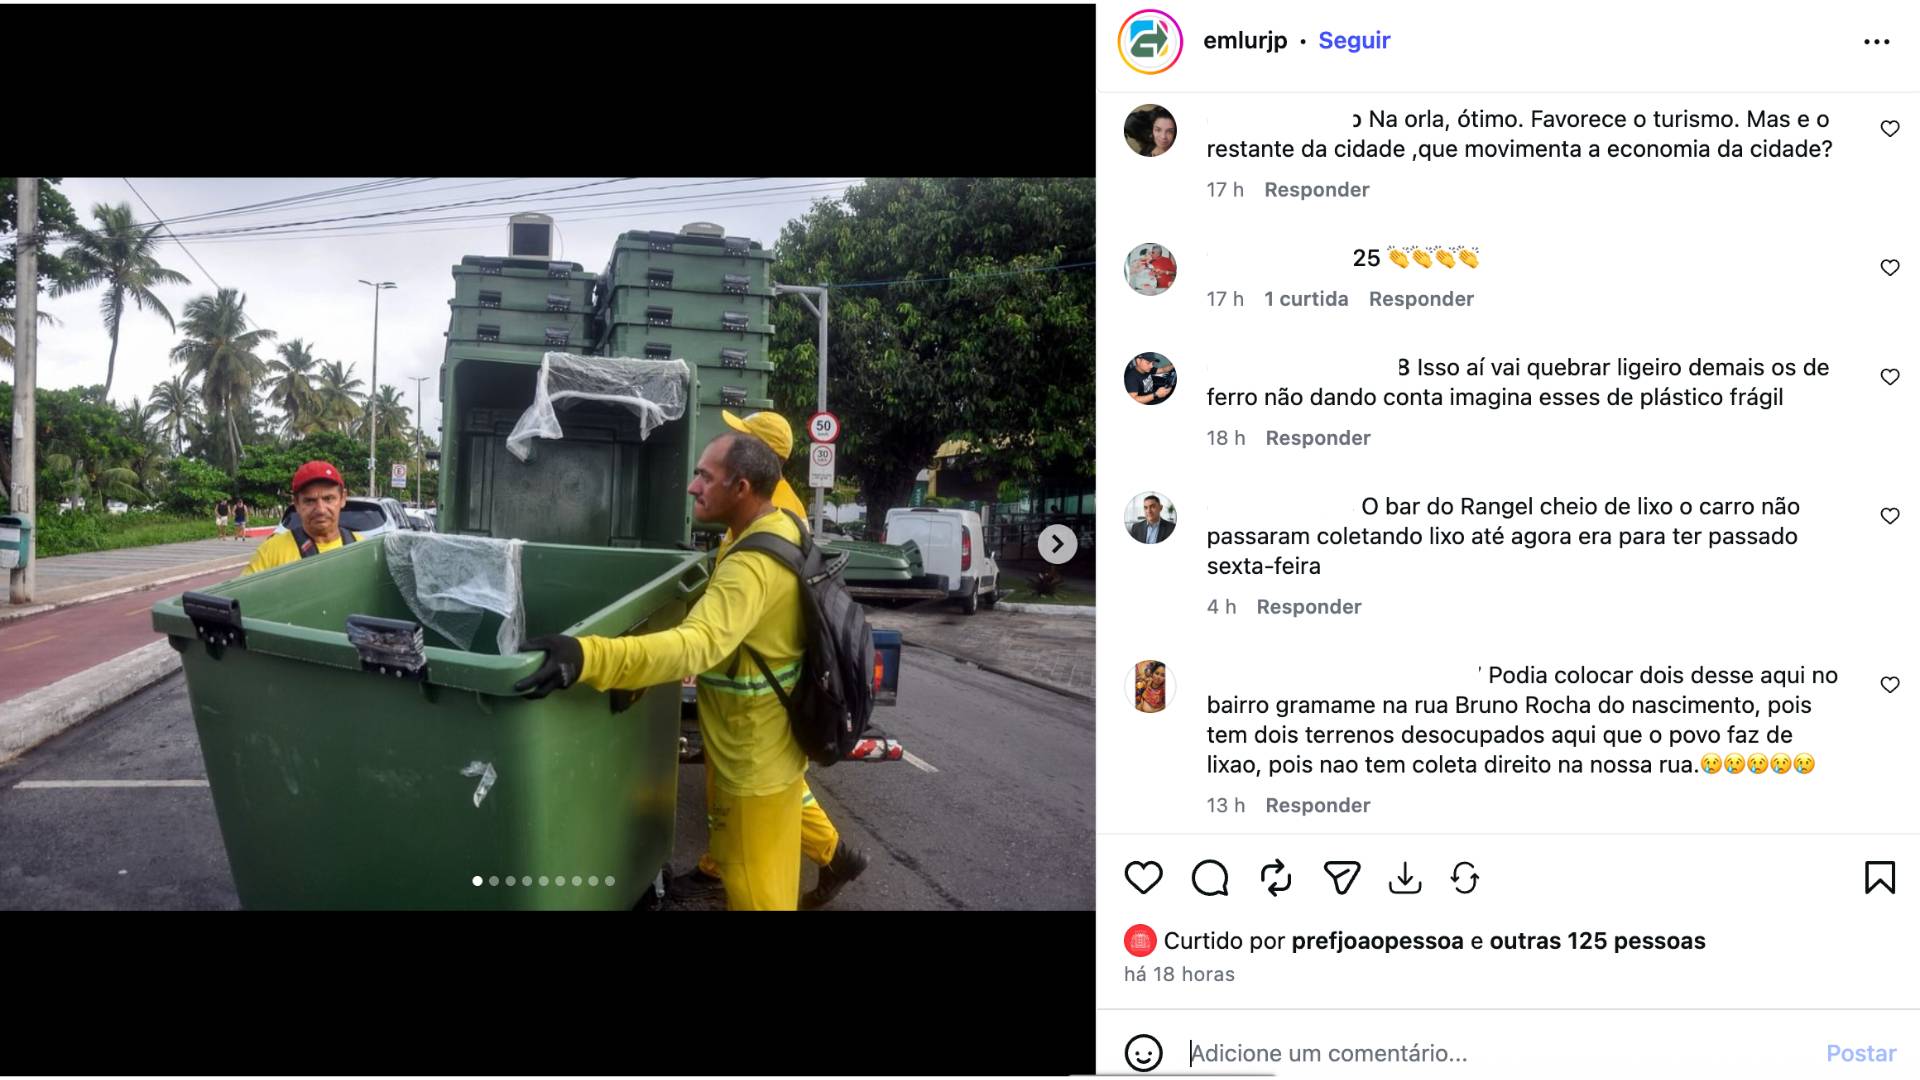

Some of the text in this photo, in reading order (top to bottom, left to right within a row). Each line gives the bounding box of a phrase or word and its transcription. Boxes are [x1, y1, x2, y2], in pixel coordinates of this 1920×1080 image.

[1203, 29, 1288, 54] emlurjp
[1318, 29, 1392, 54] Seguir
[1369, 109, 1398, 128] Na
[1404, 108, 1450, 132] orla,
[1457, 108, 1524, 128] ótimo.
[1531, 109, 1627, 129] Favorece
[1633, 113, 1647, 128] o
[1652, 108, 1740, 128] turismo.
[1747, 109, 1791, 128] Mas
[1797, 113, 1810, 128] e
[1816, 113, 1830, 128] o
[1207, 138, 1833, 162] restante da cidade ,que movimenta a economia da cidade?
[1207, 180, 1244, 198] 17 h
[1264, 180, 1371, 201] Responder
[1353, 248, 1381, 268] 25
[1206, 290, 1244, 307] 17 h
[1264, 289, 1349, 307] 1 curtida
[1369, 290, 1475, 310] Responder
[1417, 357, 1460, 377] Isso
[1466, 356, 1486, 377] aí
[1490, 357, 1521, 377] vai
[1526, 357, 1612, 381] quebrar
[1617, 357, 1682, 381] ligeiro
[1688, 357, 1765, 377] demais
[1771, 361, 1797, 377] os
[1802, 357, 1830, 377] de
[1205, 386, 1784, 411] ferro não dando conta imagina esses de plástico frágil
[816, 420, 831, 431] 50
[1207, 429, 1246, 446] 18 h
[1266, 429, 1372, 449] Responder
[817, 450, 829, 458] 30
[1361, 496, 1801, 520] O bar do Rangel cheio de lixo o carro não
[1207, 525, 1799, 550] passaram coletando lixo até agora era para ter passado
[1207, 555, 1321, 575] sexta-feira
[1206, 597, 1237, 615] 4 h
[1257, 598, 1363, 619] Responder
[1489, 664, 1839, 689] Podia colocar dois desse aqui no
[1207, 694, 1812, 718] bairro gramame na rua Bruno Rocha do nascimento, pois
[1205, 724, 1793, 748] tem dois terrenos desocupados aqui que o povo faz de
[1207, 754, 1699, 778] lixao, pois nao tem coleta direito na nossa rua.
[1207, 796, 1246, 813] 13 h
[1266, 796, 1372, 817] Responder
[1163, 929, 1707, 954] Curtido por prefjoaopessoa e outras 125 pessoas
[1124, 964, 1235, 982] há 18 horas
[1191, 1042, 1468, 1063] Adicione um comentário...
[1827, 1044, 1898, 1062] Postar
